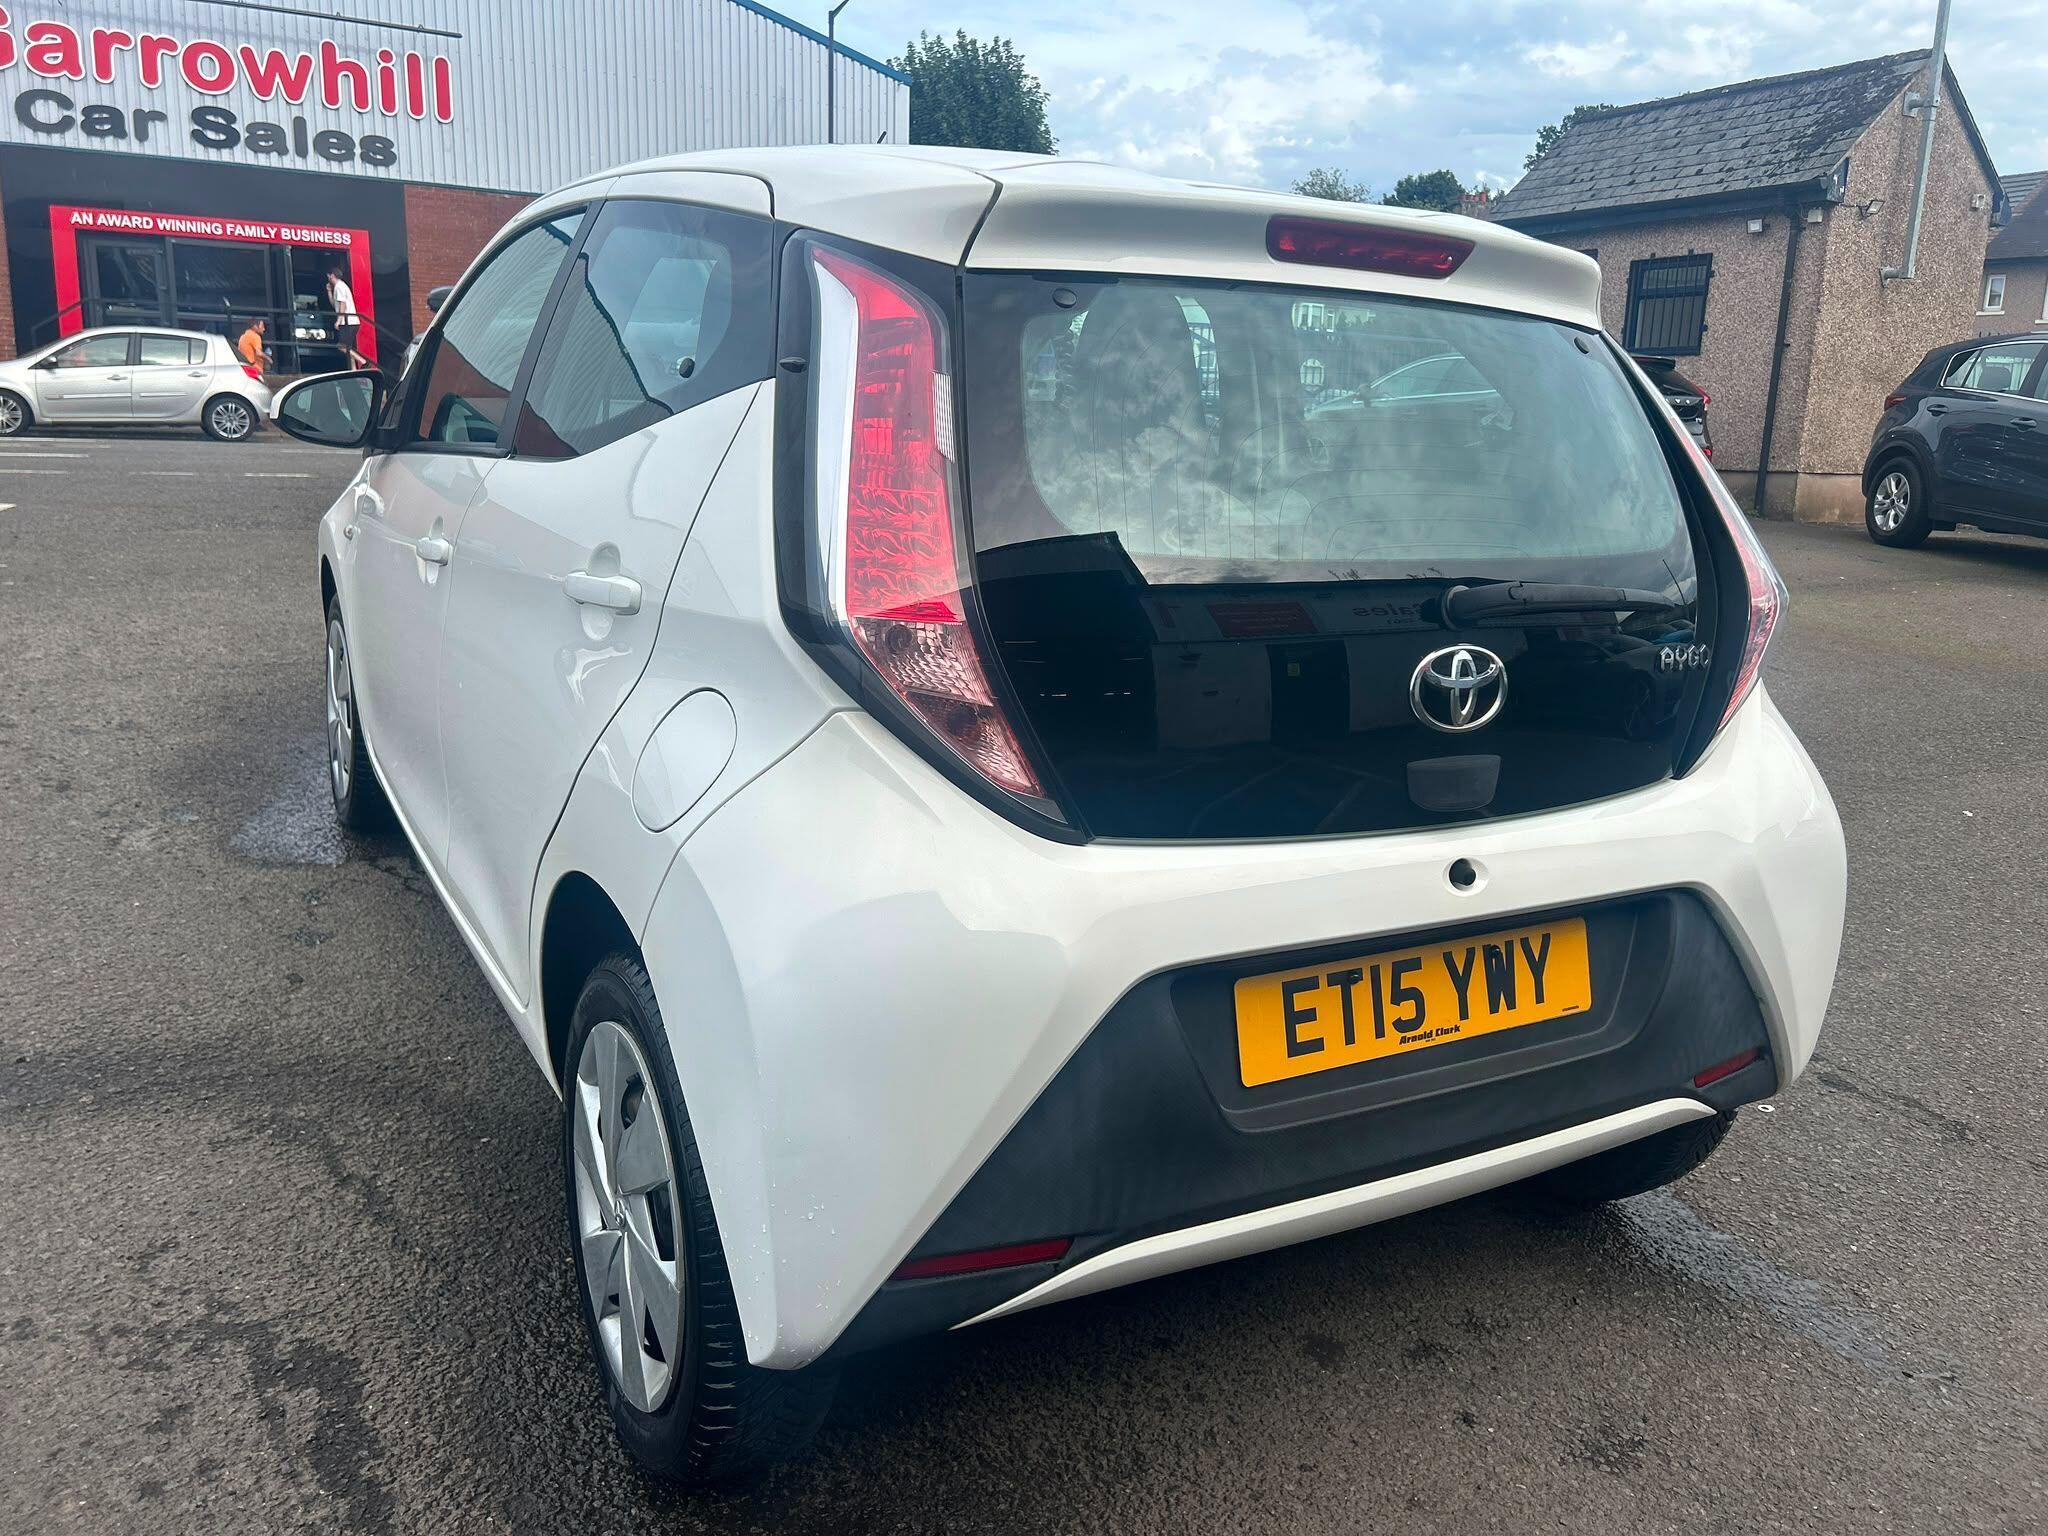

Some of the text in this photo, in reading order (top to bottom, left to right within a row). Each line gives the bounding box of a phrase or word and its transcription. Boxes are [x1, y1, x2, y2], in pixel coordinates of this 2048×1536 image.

[0, 5, 454, 123] arrowhill
[14, 88, 398, 167] Car Sales
[70, 211, 352, 245] AN AWARD WINNING FAMILY BUSINESS
[1282, 933, 1551, 1058] ET15 YWY
[1399, 1024, 1461, 1045] Arnold Clark
